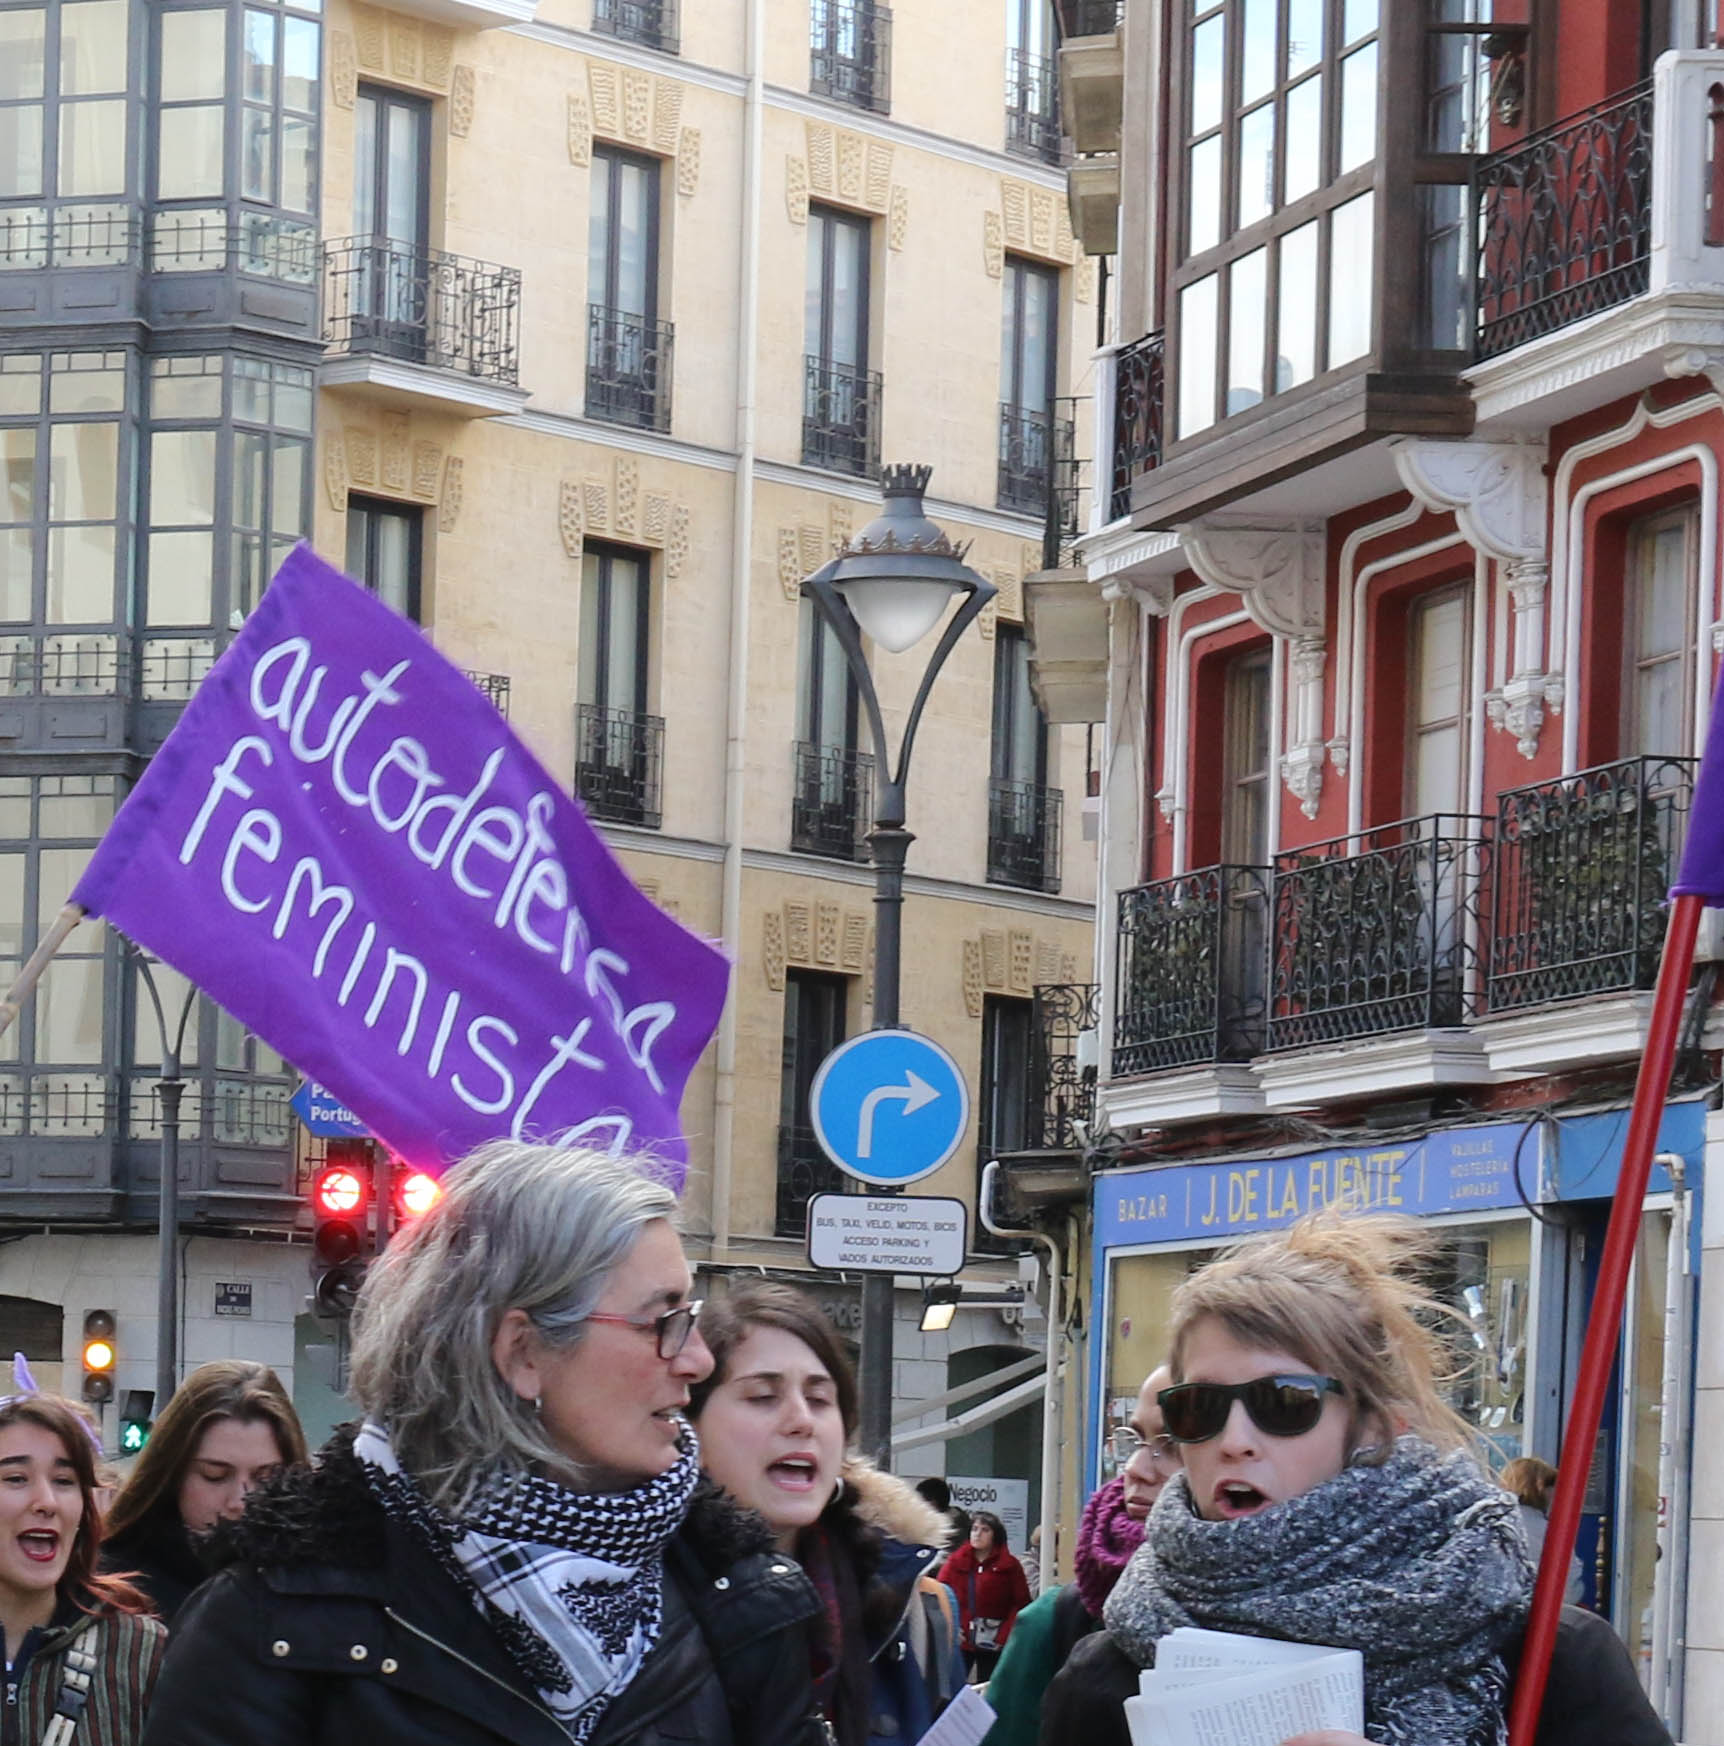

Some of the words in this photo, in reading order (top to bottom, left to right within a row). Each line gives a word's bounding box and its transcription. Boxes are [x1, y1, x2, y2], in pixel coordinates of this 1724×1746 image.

[249, 636, 678, 1095] autodefensa
[1119, 1194, 1168, 1222] BAZAR
[1202, 1174, 1220, 1225] J.
[1228, 1169, 1259, 1223] DE
[1267, 1167, 1300, 1219] LA
[1309, 1151, 1405, 1213] FUENTE
[867, 1202, 908, 1213] EXCEPTO
[842, 1237, 879, 1247] ACCESO
[882, 1238, 920, 1248] PARKING
[838, 1252, 867, 1263] VADOS
[871, 1254, 933, 1266] AUTORIZADOS
